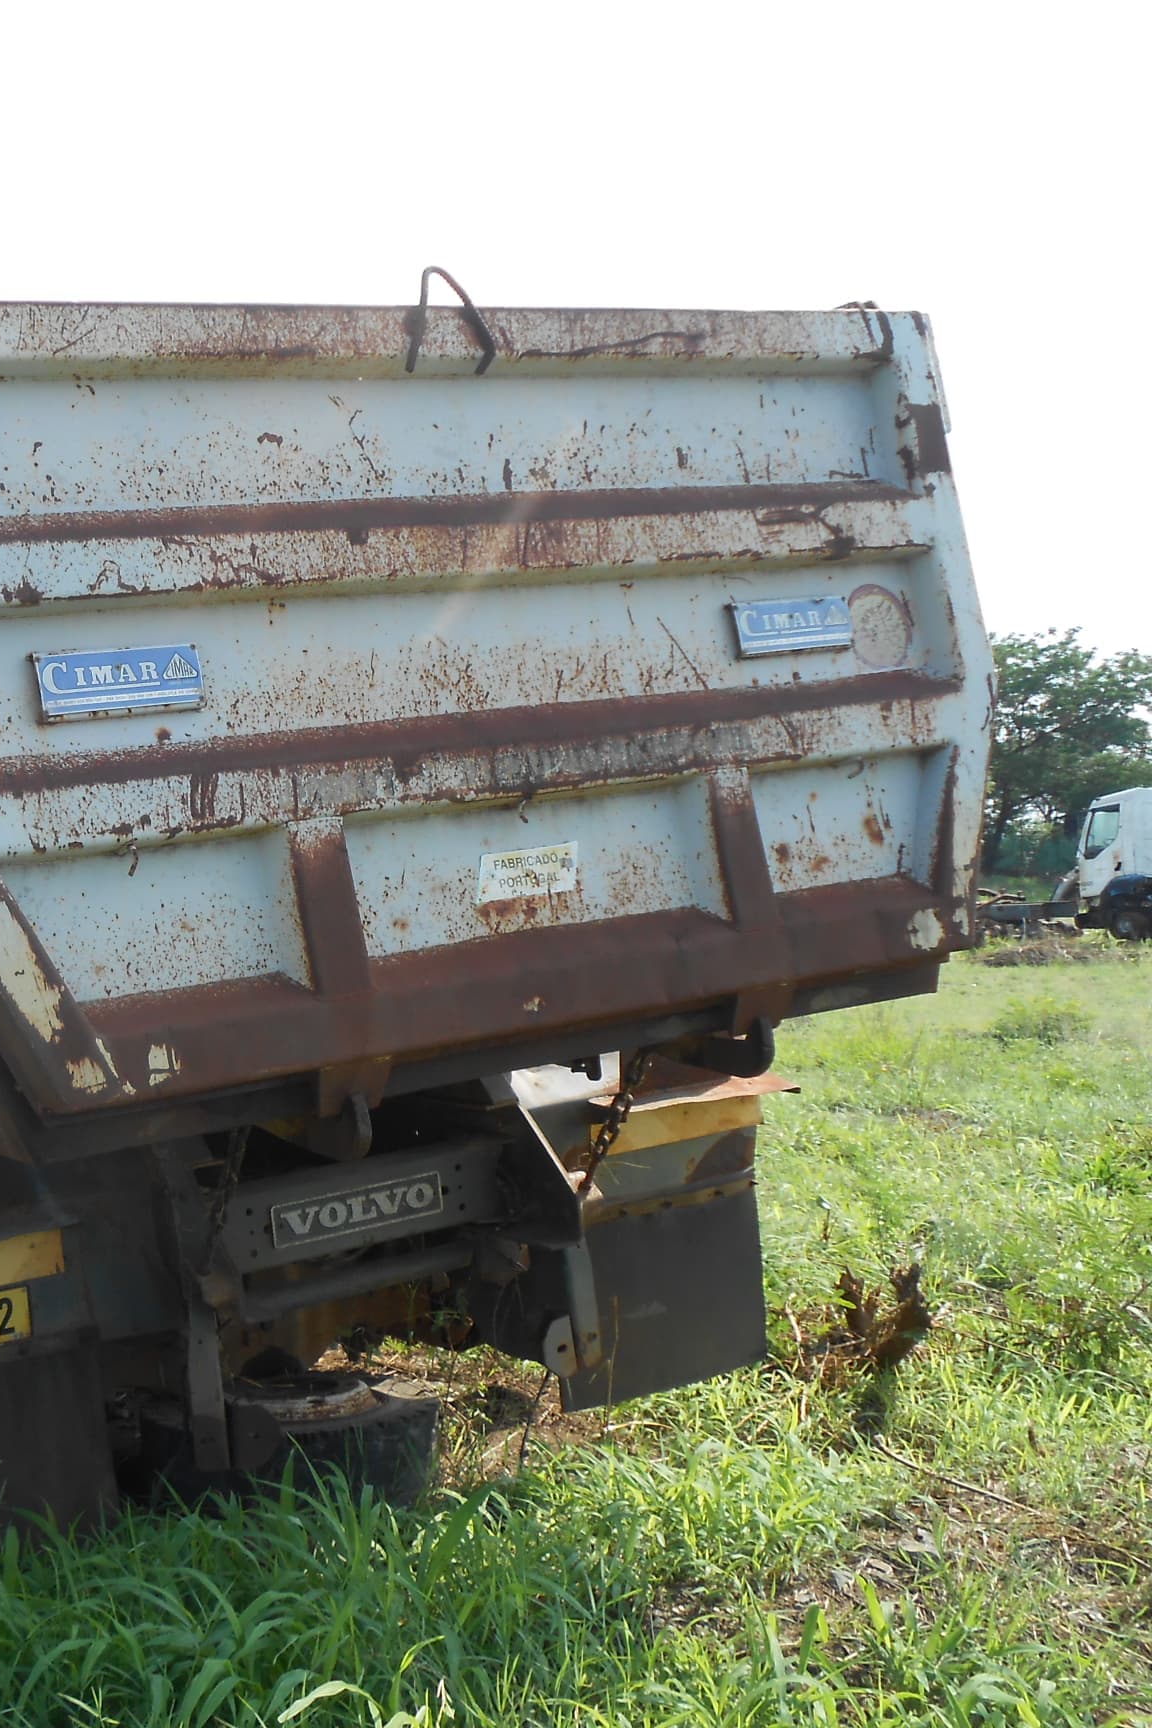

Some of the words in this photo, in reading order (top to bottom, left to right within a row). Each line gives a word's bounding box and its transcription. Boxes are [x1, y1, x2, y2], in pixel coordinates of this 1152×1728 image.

[740, 610, 822, 636] CIMAR
[42, 661, 160, 694] CIMAR
[493, 853, 558, 870] FABRICADO
[280, 1182, 435, 1234] VOLVO
